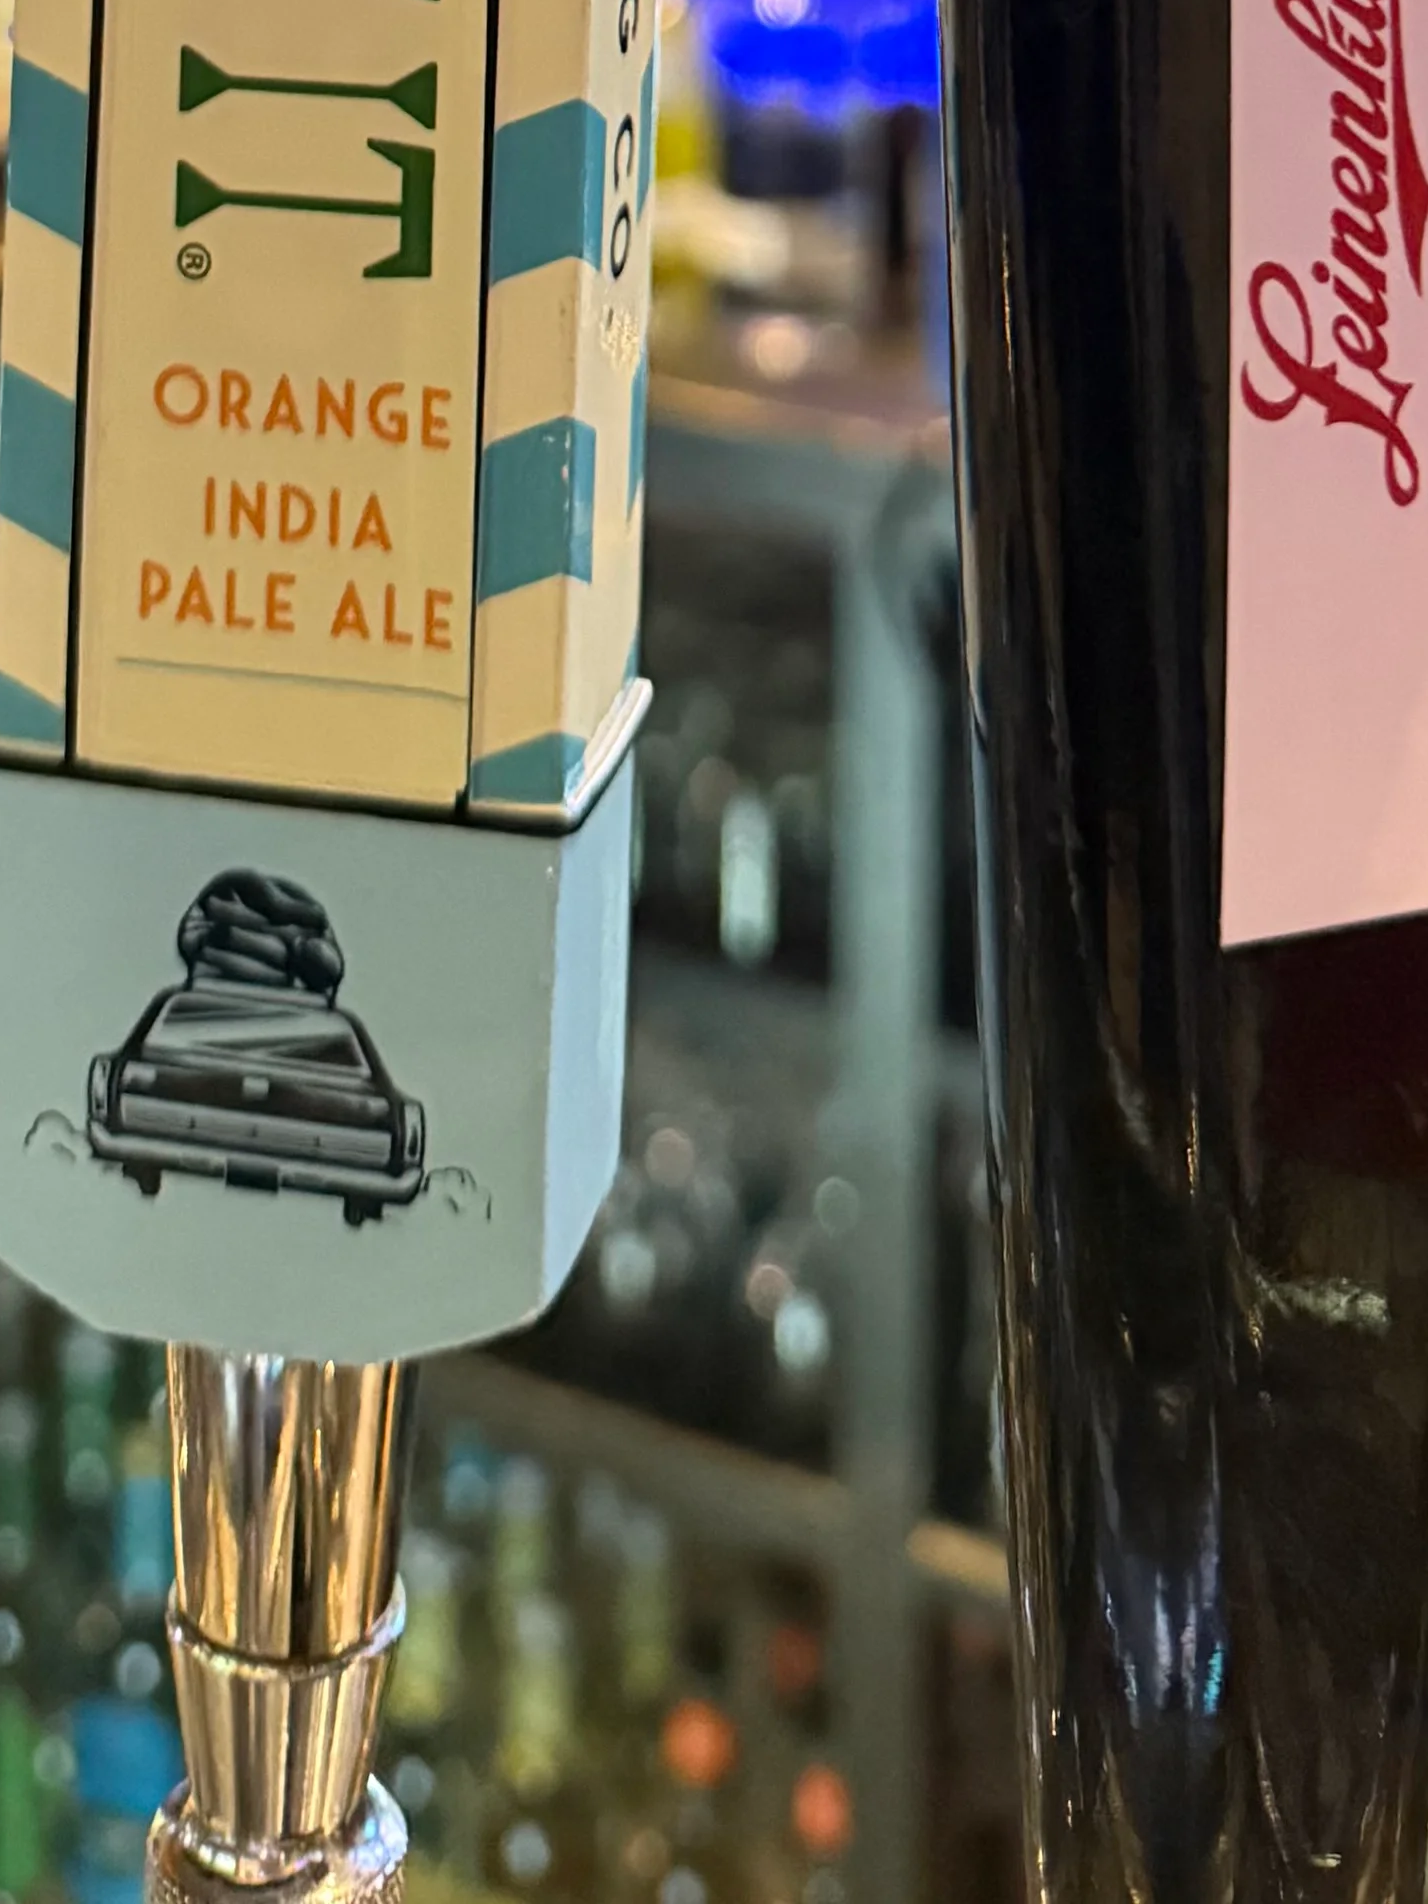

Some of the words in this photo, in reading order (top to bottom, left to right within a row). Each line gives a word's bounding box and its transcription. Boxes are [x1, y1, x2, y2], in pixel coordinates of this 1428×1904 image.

[152, 361, 452, 452] ORANGE
[203, 476, 394, 553] INDIA
[138, 558, 297, 635] PALE
[329, 578, 454, 652] ALE
